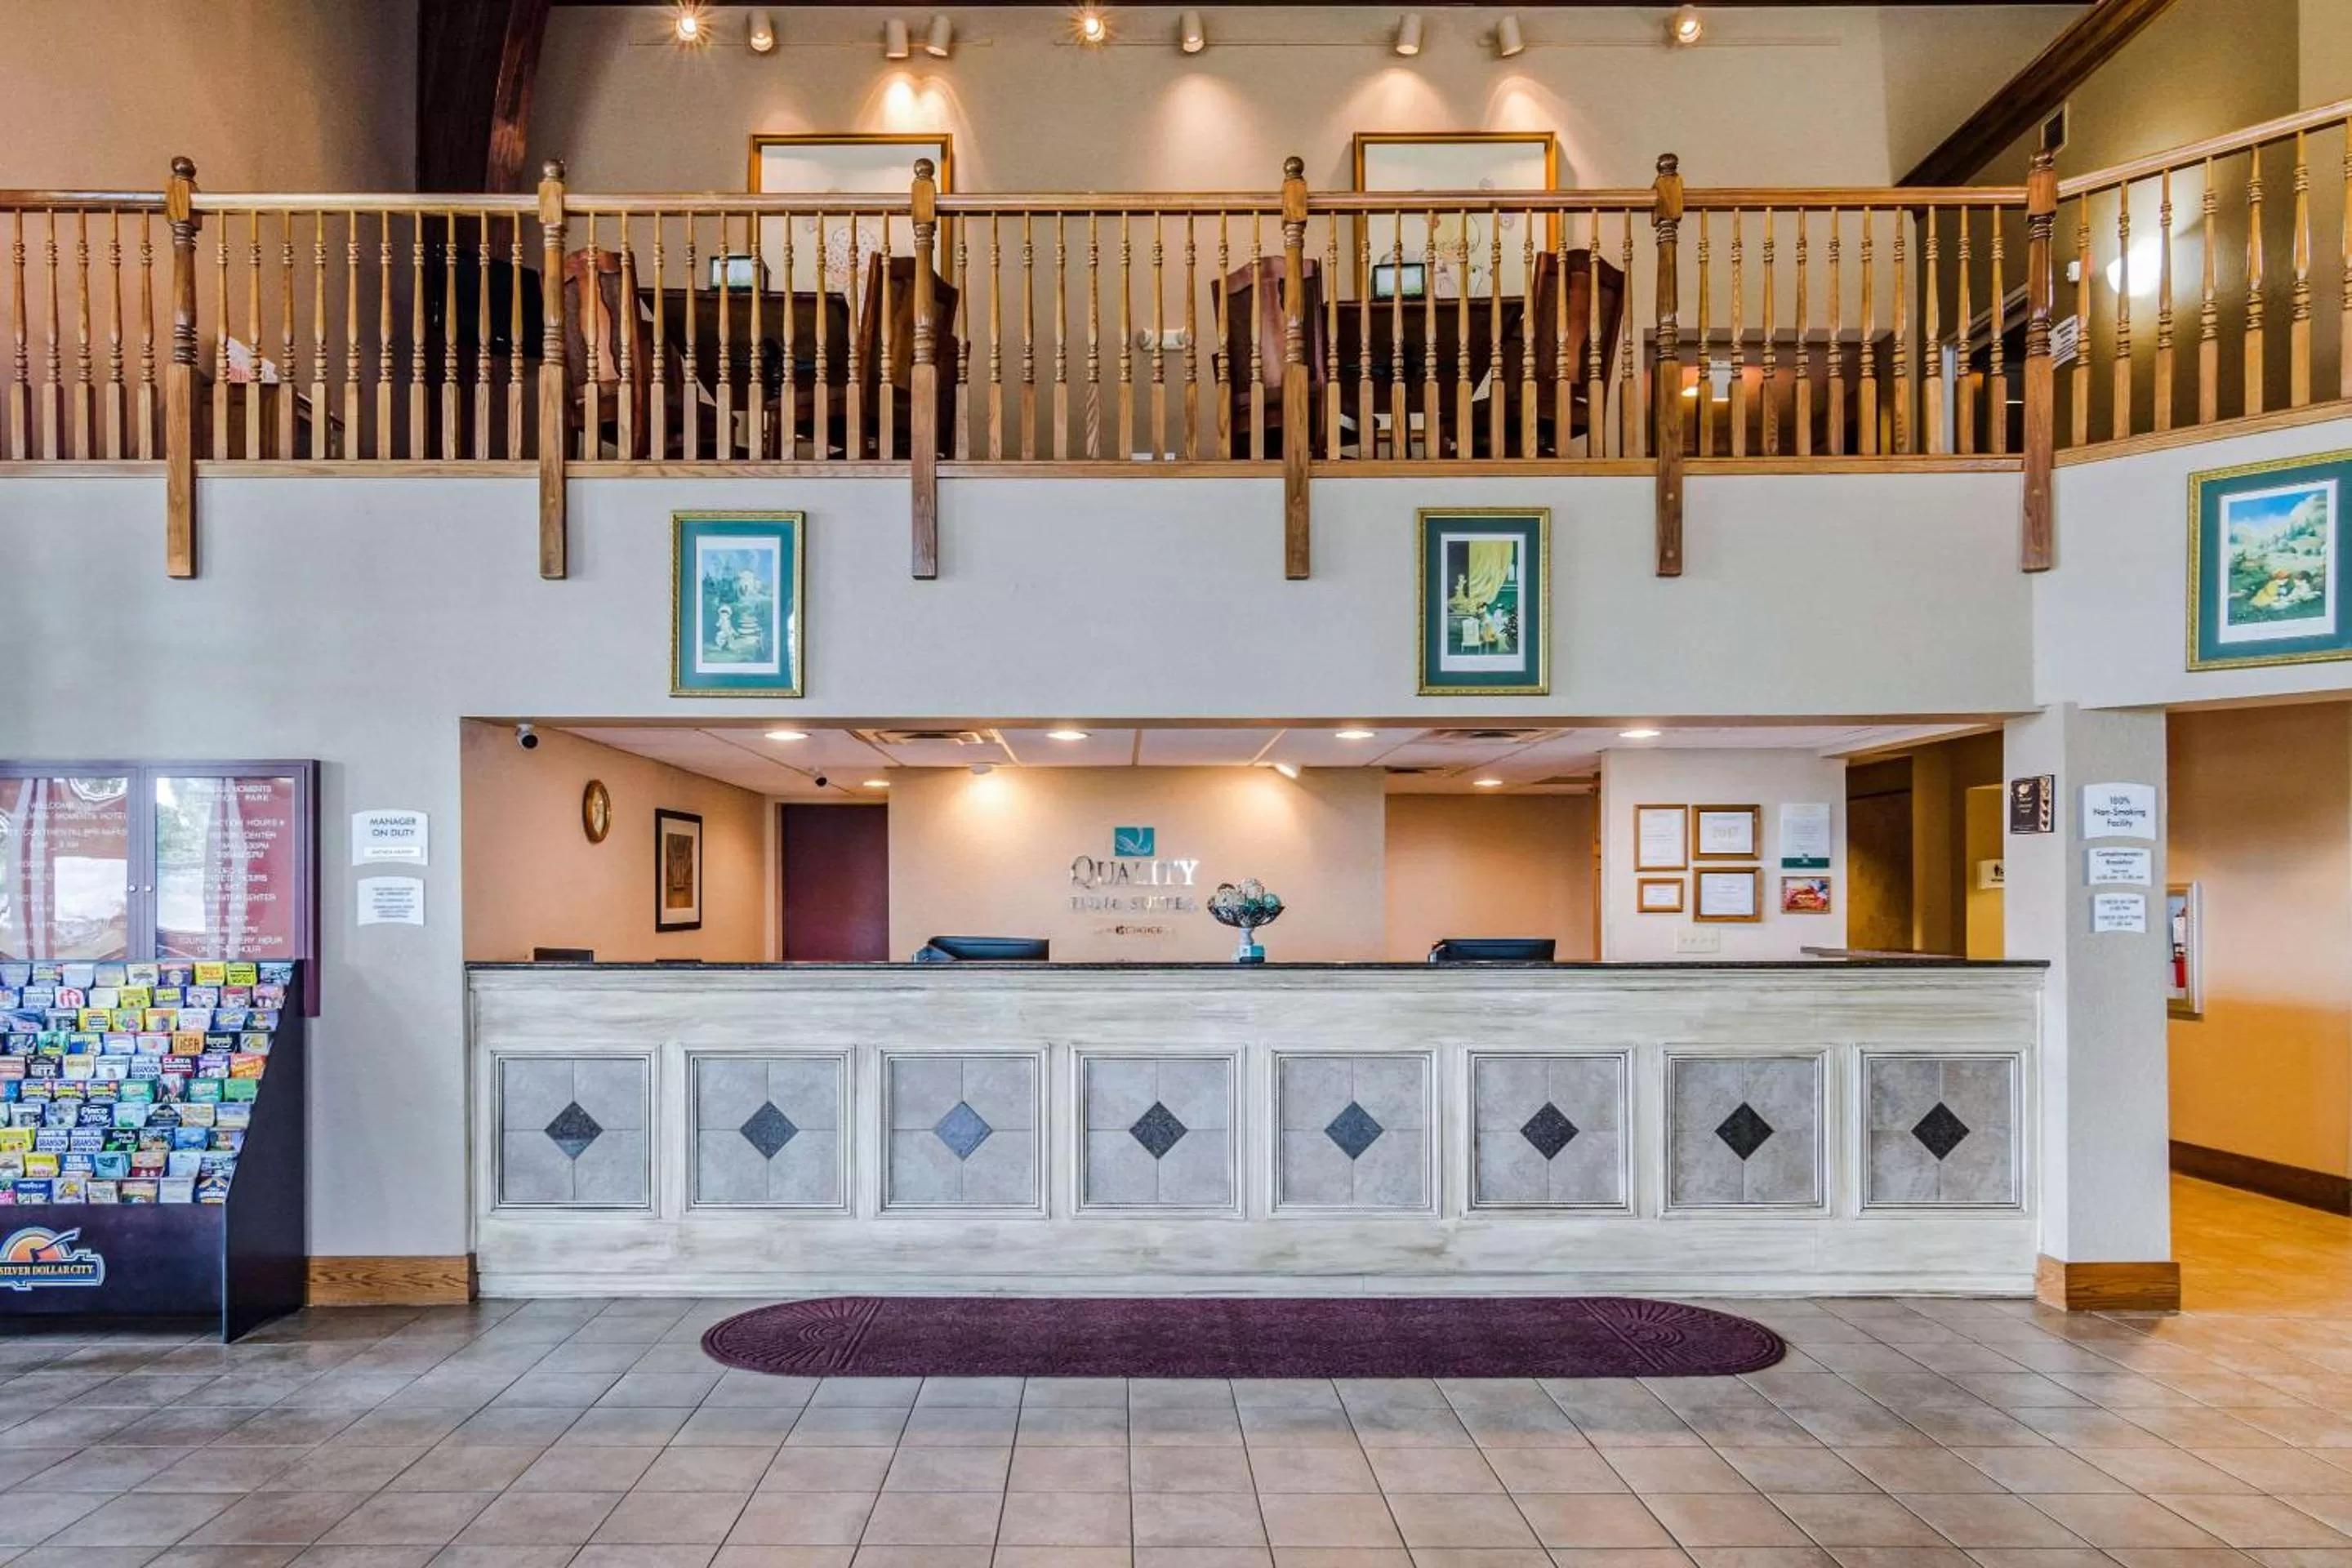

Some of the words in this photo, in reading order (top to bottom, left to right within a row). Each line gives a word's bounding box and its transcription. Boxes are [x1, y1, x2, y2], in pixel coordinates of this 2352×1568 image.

[2093, 808, 2146, 817] Non-Smoking
[369, 817, 416, 826] MANAGER
[2107, 818, 2133, 830] Facility
[372, 829, 388, 837] ON
[390, 829, 415, 837] DUTY
[1070, 855, 1200, 890] QUALITY
[0, 1267, 30, 1276] SILVER
[33, 1265, 70, 1275] DOLLAR
[70, 1264, 94, 1275] CITY
